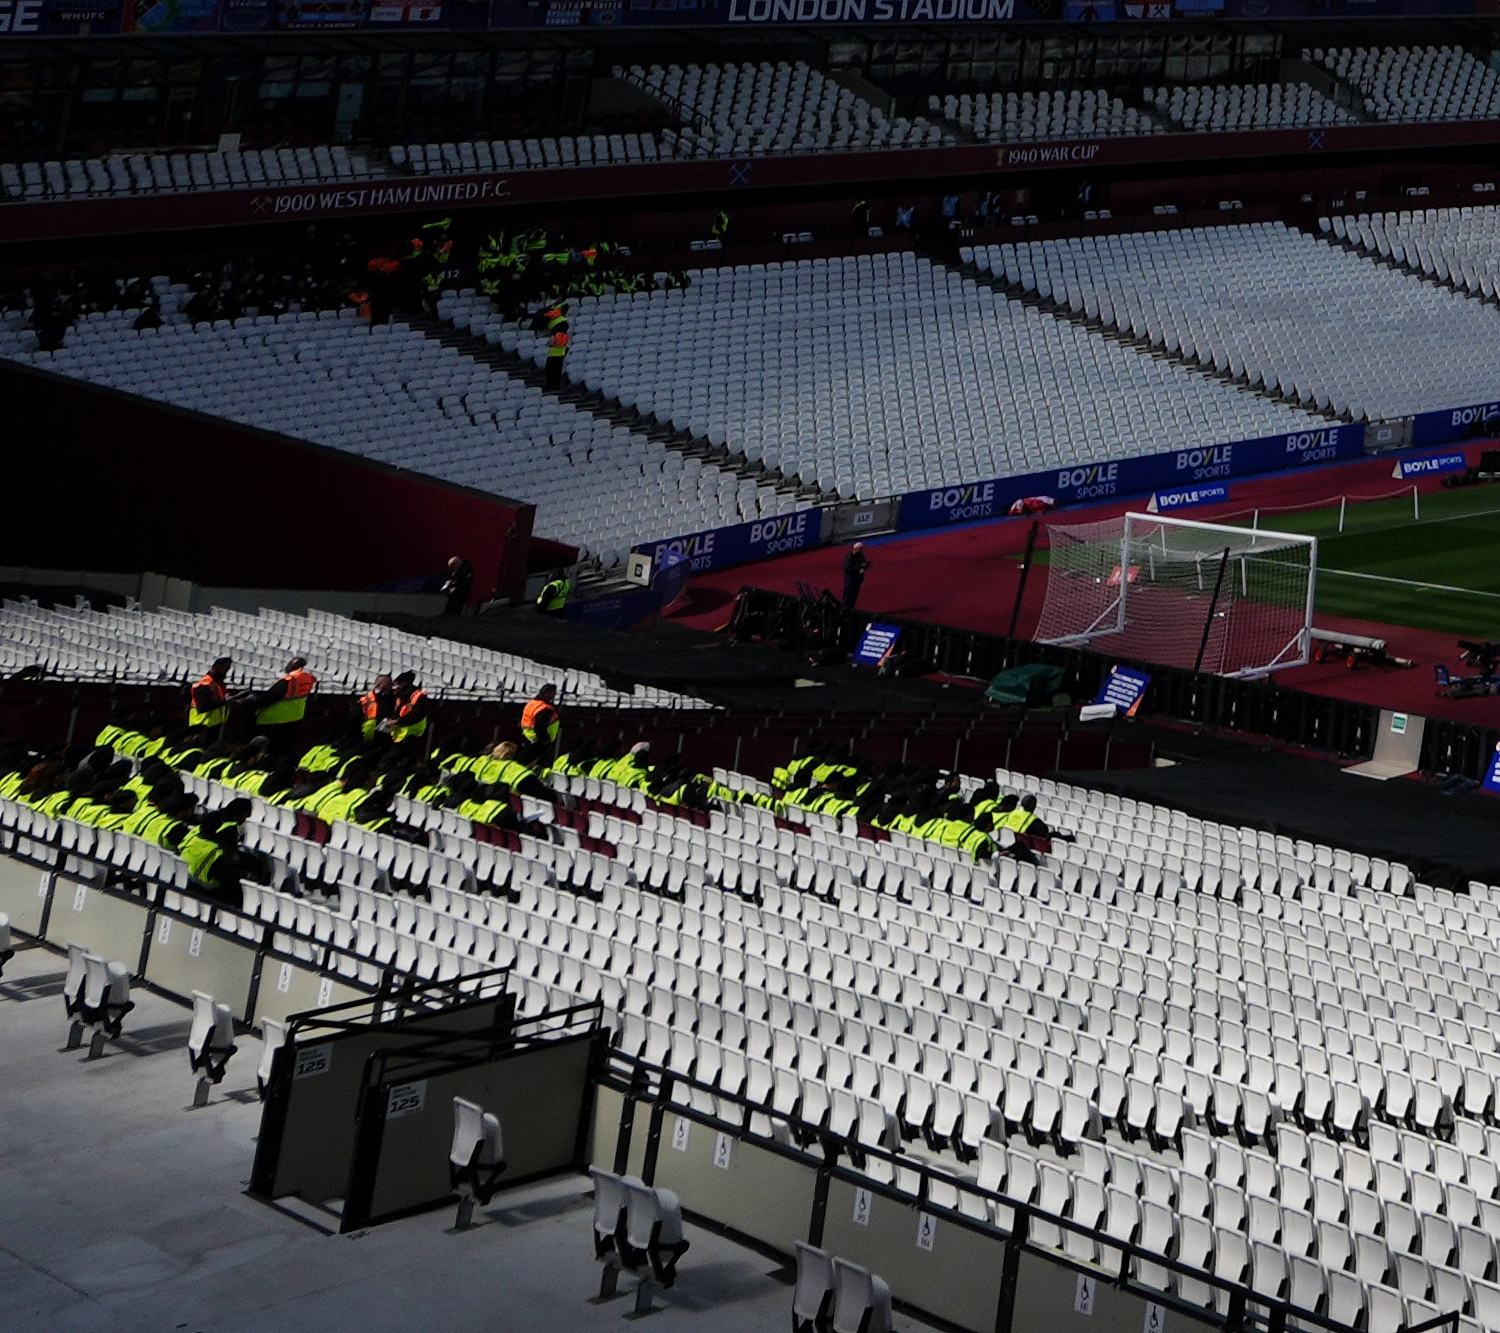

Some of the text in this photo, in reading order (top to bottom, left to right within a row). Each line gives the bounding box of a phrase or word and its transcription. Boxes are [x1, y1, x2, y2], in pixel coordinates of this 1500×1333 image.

[1008, 145, 1099, 164] 1940 WAR CUP
[274, 180, 511, 214] 1900 WEST HAM UNITED F.C.
[1286, 429, 1339, 452] BOYLE
[1176, 445, 1233, 471] BOYLE
[1302, 446, 1337, 461] SPORTS
[1194, 464, 1231, 480] SPORTS
[1403, 455, 1462, 473] BOYLE SPORTS
[1058, 463, 1118, 489] BOYLE
[930, 483, 995, 511] BOYLE
[1076, 482, 1117, 499] SPORTS
[1160, 487, 1225, 506] BOYLE SPORTS
[949, 502, 993, 521] SPORTS
[750, 513, 807, 544] BOYLE
[766, 534, 804, 555] SPORTS
[298, 1059, 326, 1076] 125
[390, 1095, 420, 1113] 125
